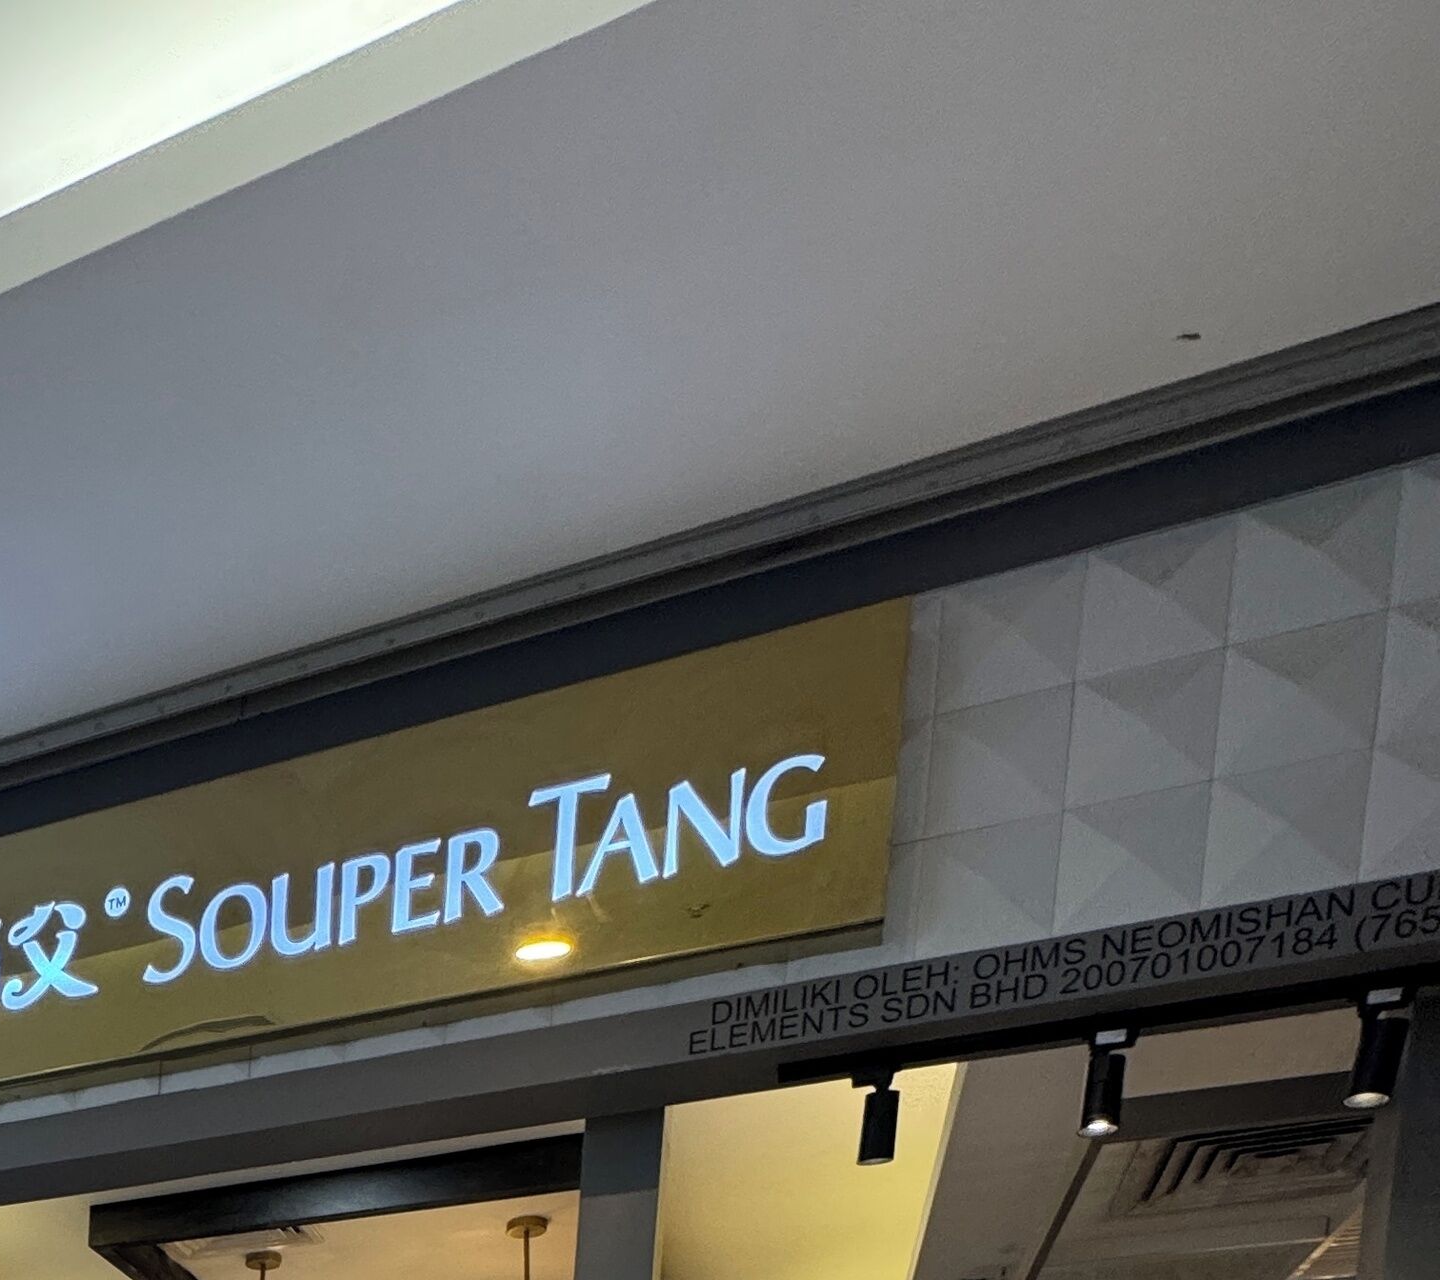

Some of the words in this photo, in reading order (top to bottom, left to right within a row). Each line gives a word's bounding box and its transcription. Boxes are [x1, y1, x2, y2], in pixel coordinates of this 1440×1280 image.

[141, 826, 505, 986] SOUPER
[527, 753, 828, 904] TANG
[689, 1002, 870, 1056] ELEMENTS
[881, 988, 956, 1024] SDN
[969, 973, 1048, 1010] BHD
[1059, 923, 1339, 995] 200701007184
[710, 979, 841, 1026] DIMILIKI
[853, 961, 959, 1000] OLEH:
[973, 938, 1087, 981] OHMS
[1102, 888, 1355, 960] NEOMISHAN
[1370, 875, 1440, 911] CU
